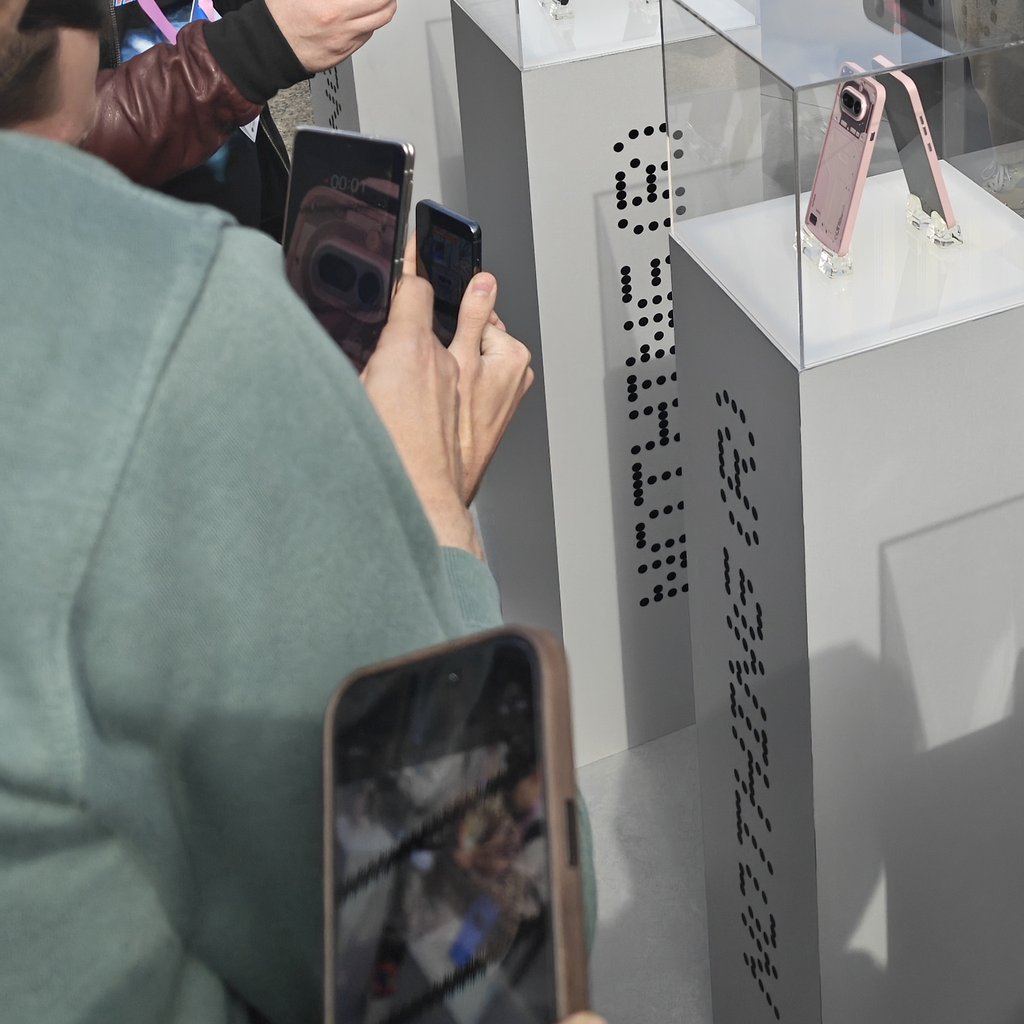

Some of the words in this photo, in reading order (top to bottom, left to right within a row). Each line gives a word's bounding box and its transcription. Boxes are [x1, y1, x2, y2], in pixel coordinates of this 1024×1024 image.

[330, 175, 366, 193] 00:01
[620, 255, 689, 608] NOTHING
[723, 546, 780, 1021] NOTHING
